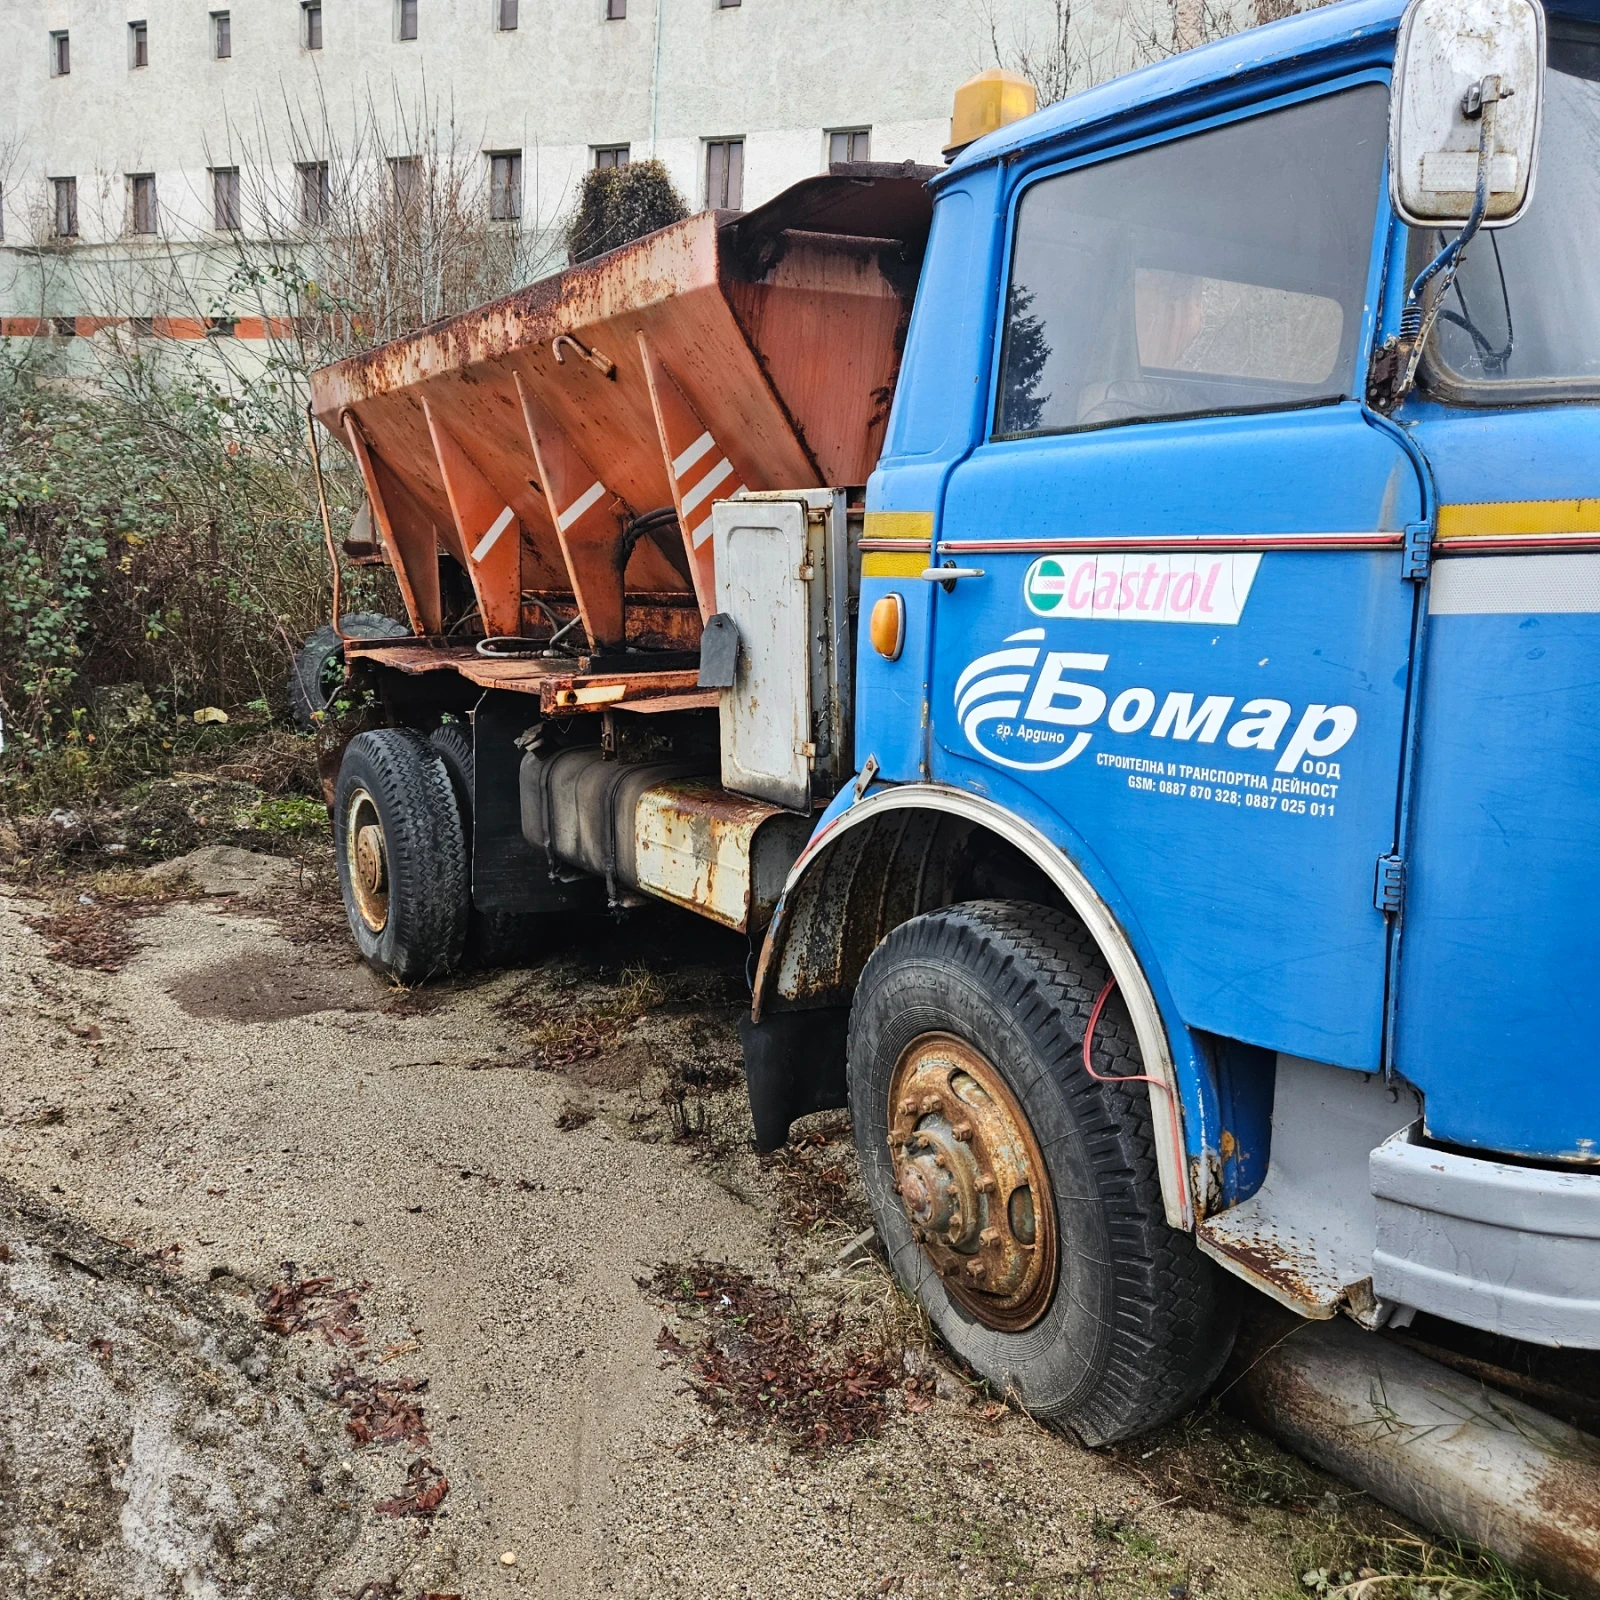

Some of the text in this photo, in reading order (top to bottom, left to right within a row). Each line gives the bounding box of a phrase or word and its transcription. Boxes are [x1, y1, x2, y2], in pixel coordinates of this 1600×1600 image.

[1067, 561, 1222, 613] Castrol
[996, 724, 1065, 744] гр. Ардино
[1023, 652, 1358, 773] Бомар
[1096, 752, 1339, 799] СТРОИТЕЛНА И ТРАНСПОРТНА ДЕЙНОСТ
[1128, 775, 1335, 817] GSM: 0887 870 328; 0887 025 011
